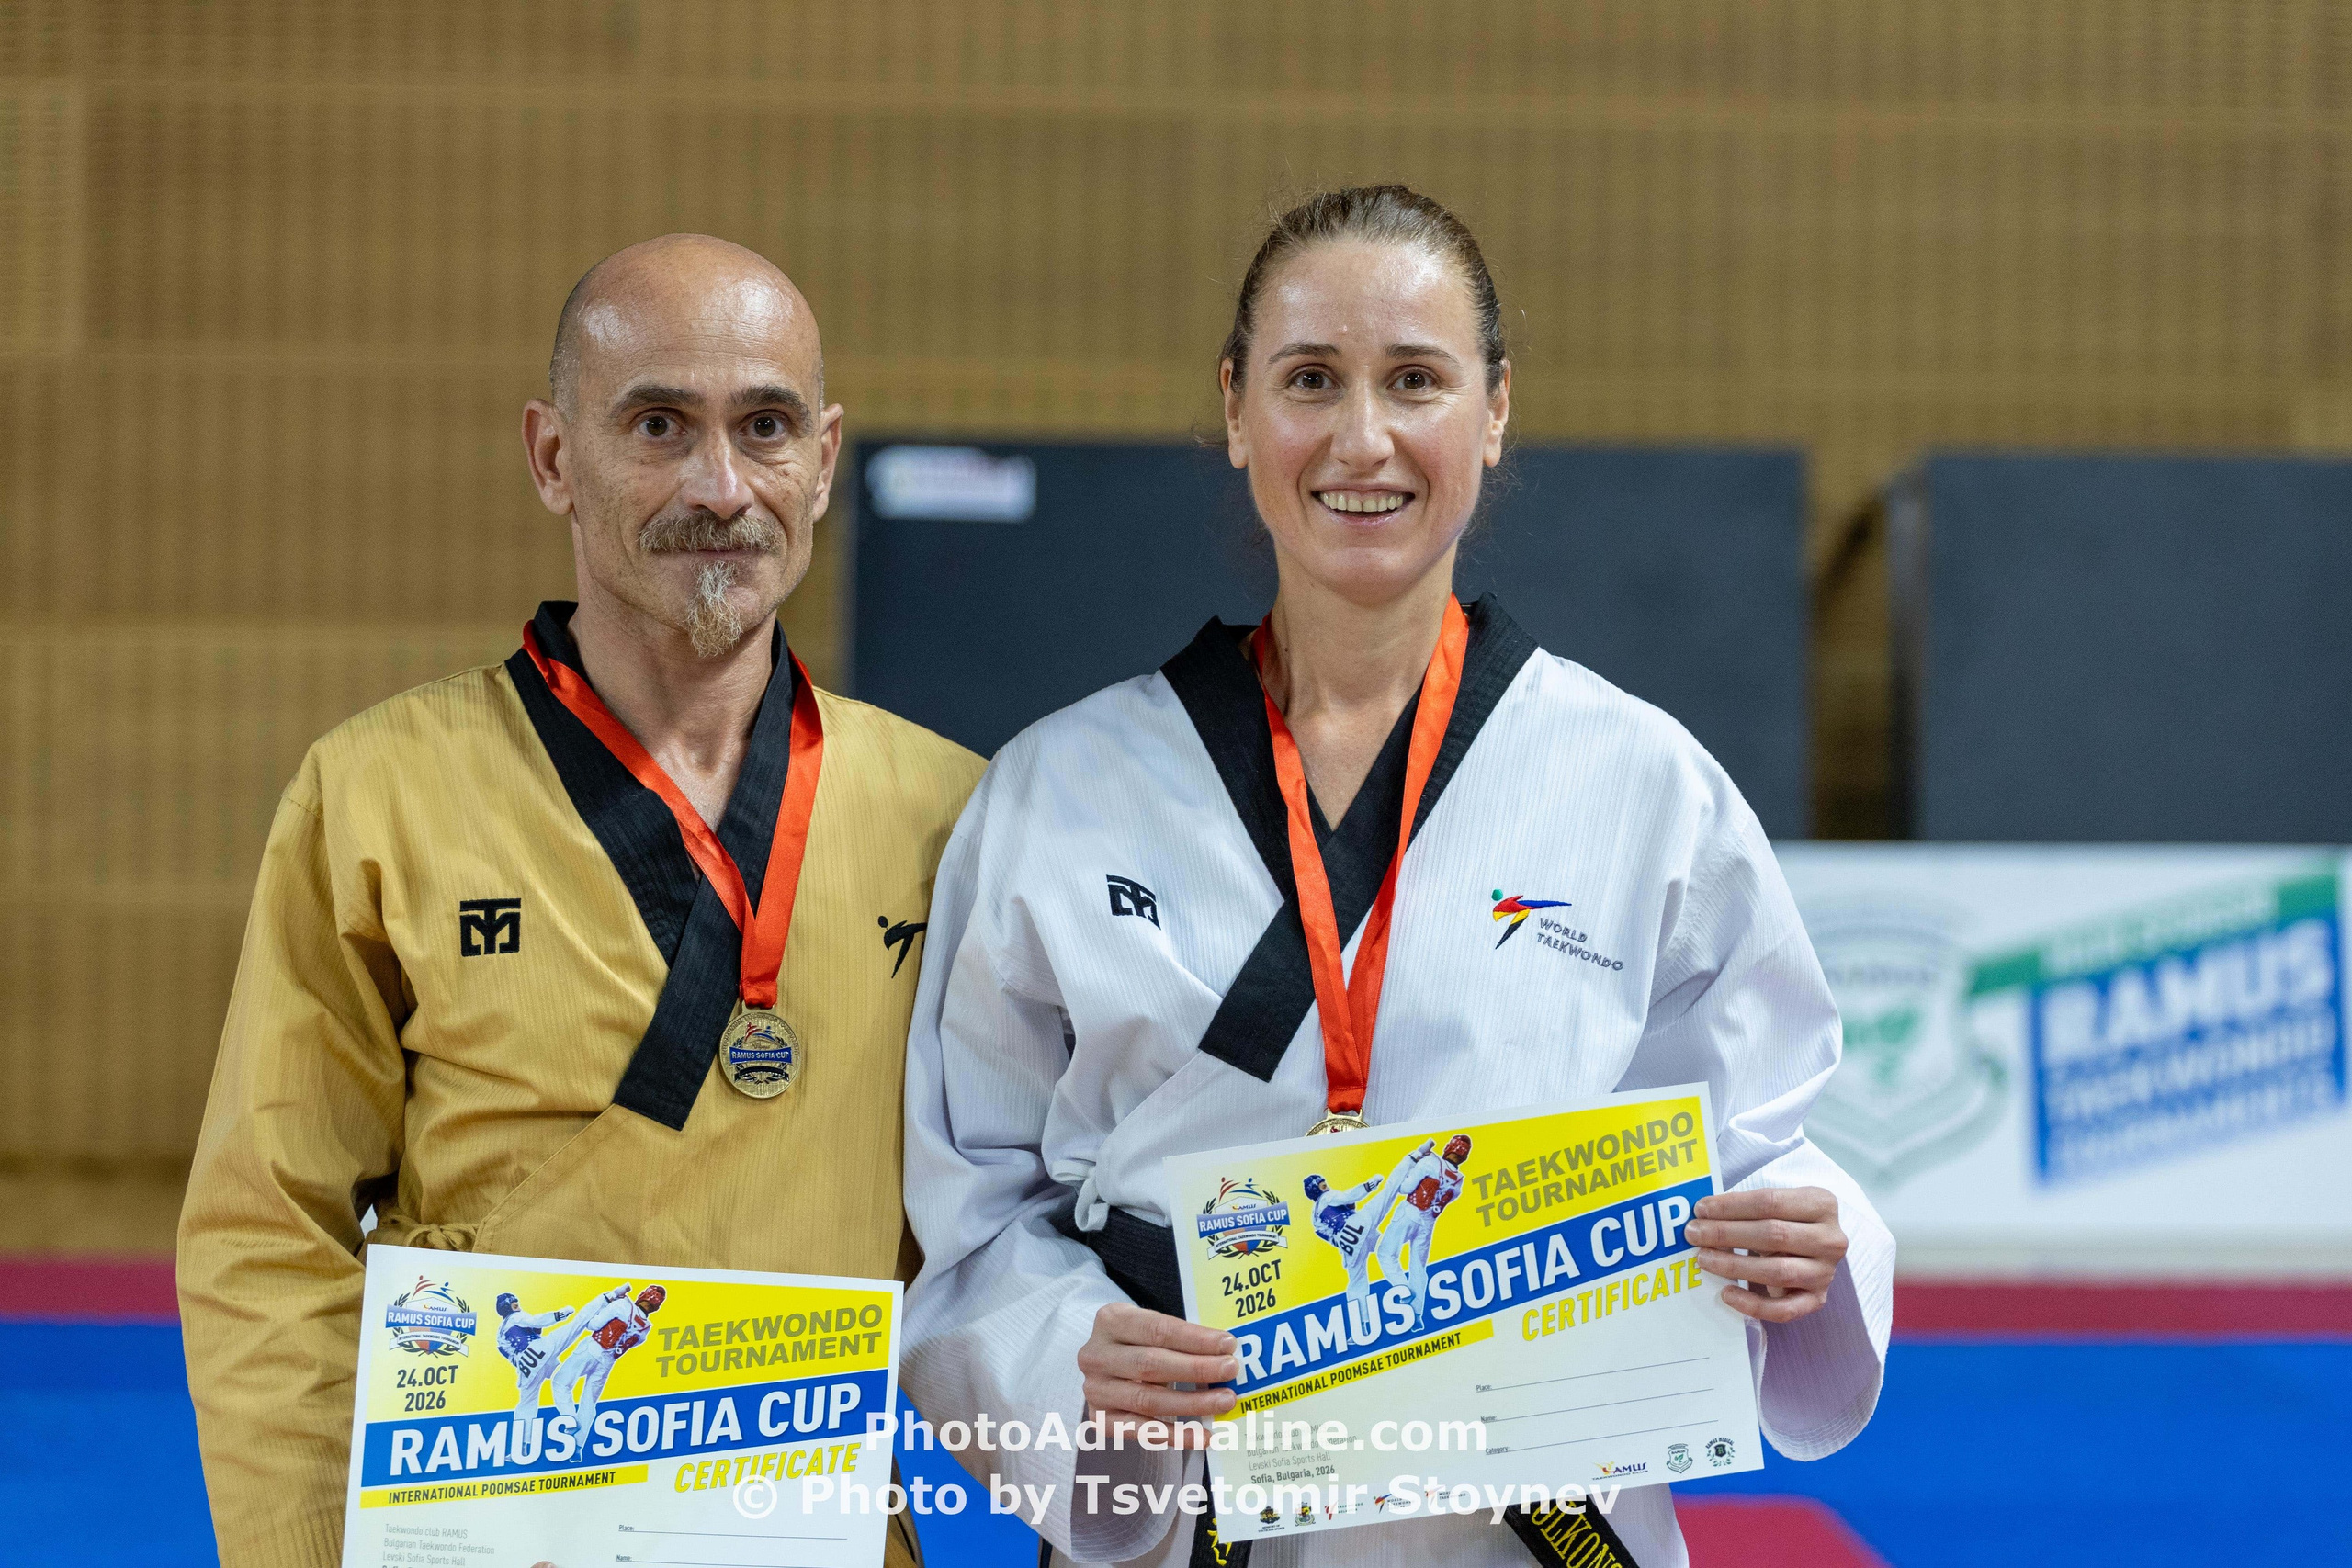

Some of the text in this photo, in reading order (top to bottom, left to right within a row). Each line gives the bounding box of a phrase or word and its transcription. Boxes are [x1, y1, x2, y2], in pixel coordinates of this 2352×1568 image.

[1540, 918, 1588, 943] WORLD
[1537, 932, 1624, 971] TAEKWONDO
[2045, 921, 2331, 1065] RAMUS
[731, 1051, 755, 1059] RAMUS
[756, 1051, 775, 1059] SOFIA
[1471, 1111, 1694, 1201] TAEKWONDO
[1476, 1138, 1697, 1227] TOURNAMENT
[1199, 1209, 1287, 1232] RAMUS SOFIA CUP
[1340, 1224, 1364, 1256] BUL
[1222, 1258, 1281, 1296] 24.OCT
[1236, 1195, 1690, 1386] RAMUS SOFIA CUP
[1235, 1288, 1276, 1318] 2026
[1522, 1257, 1702, 1341] CERTIFICATE
[388, 1312, 475, 1329] RAMUS SOFIA CUP
[658, 1304, 883, 1351] TAEKWONDO
[519, 1347, 546, 1379] BUL
[656, 1332, 882, 1378] TOURNAMENT
[397, 1365, 458, 1389] 24.OCT
[1240, 1333, 1462, 1414] INTERNATIONAL POOMSAE TOURNAMENT
[404, 1391, 446, 1412] 2026
[390, 1382, 861, 1476] RAMUS SOFIA CUP
[1705, 1438, 1734, 1449] RAMUS MEDICAL
[674, 1442, 862, 1493] CERTIFICATE
[1249, 1451, 1331, 1471] Levski Sofia Sports Hall
[1251, 1465, 1335, 1484] Sofia, Bulgaria, 2026
[389, 1472, 616, 1504] INTERNATIONAL POOMSAE TOURNAMENT
[384, 1538, 494, 1555] Bulgarian Taekwondo Federation
[385, 1524, 468, 1539] Taekwondo club RAMUS
[383, 1551, 466, 1566] Levski Sofia Sports Hall
